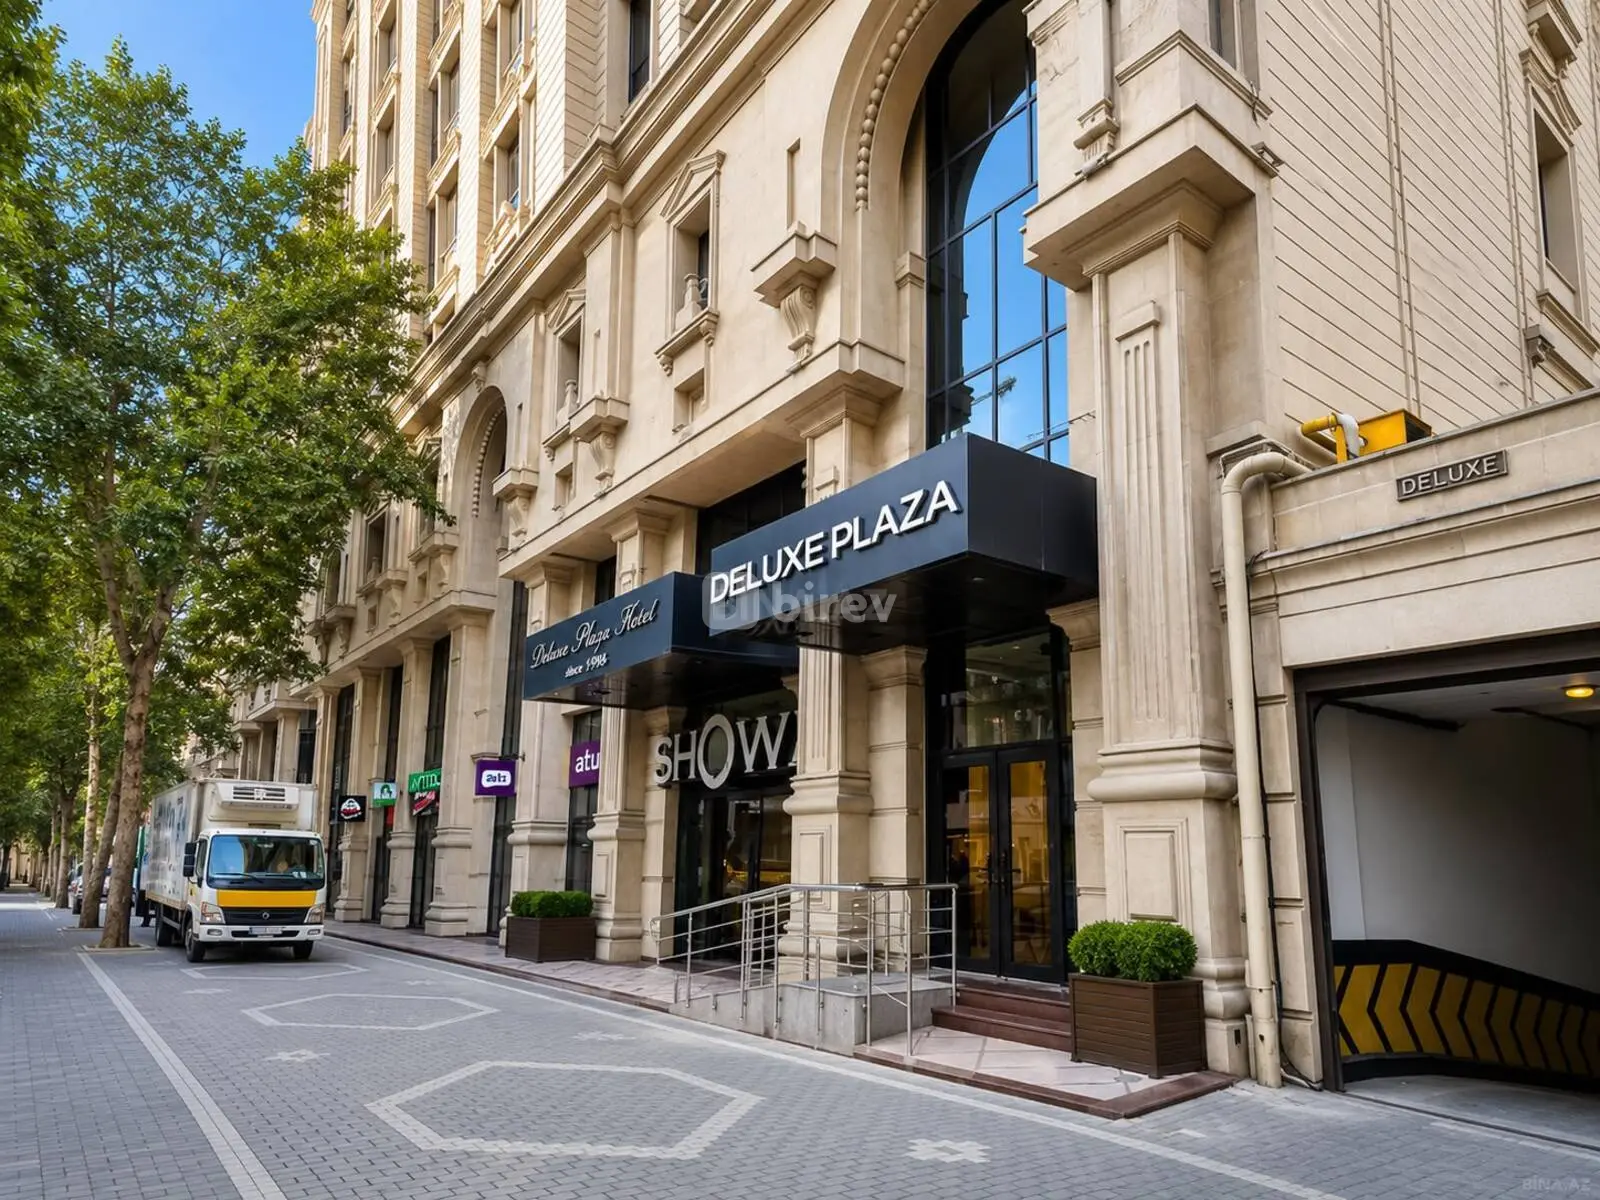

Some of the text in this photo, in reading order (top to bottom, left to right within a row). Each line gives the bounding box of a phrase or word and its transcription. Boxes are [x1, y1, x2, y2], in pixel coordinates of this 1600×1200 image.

[1401, 455, 1499, 495] DELUXE
[711, 480, 960, 604] DELUXE PLAZA
[571, 620, 611, 654] Plaza
[614, 598, 660, 636] Hotel
[655, 710, 798, 790] SHOW
